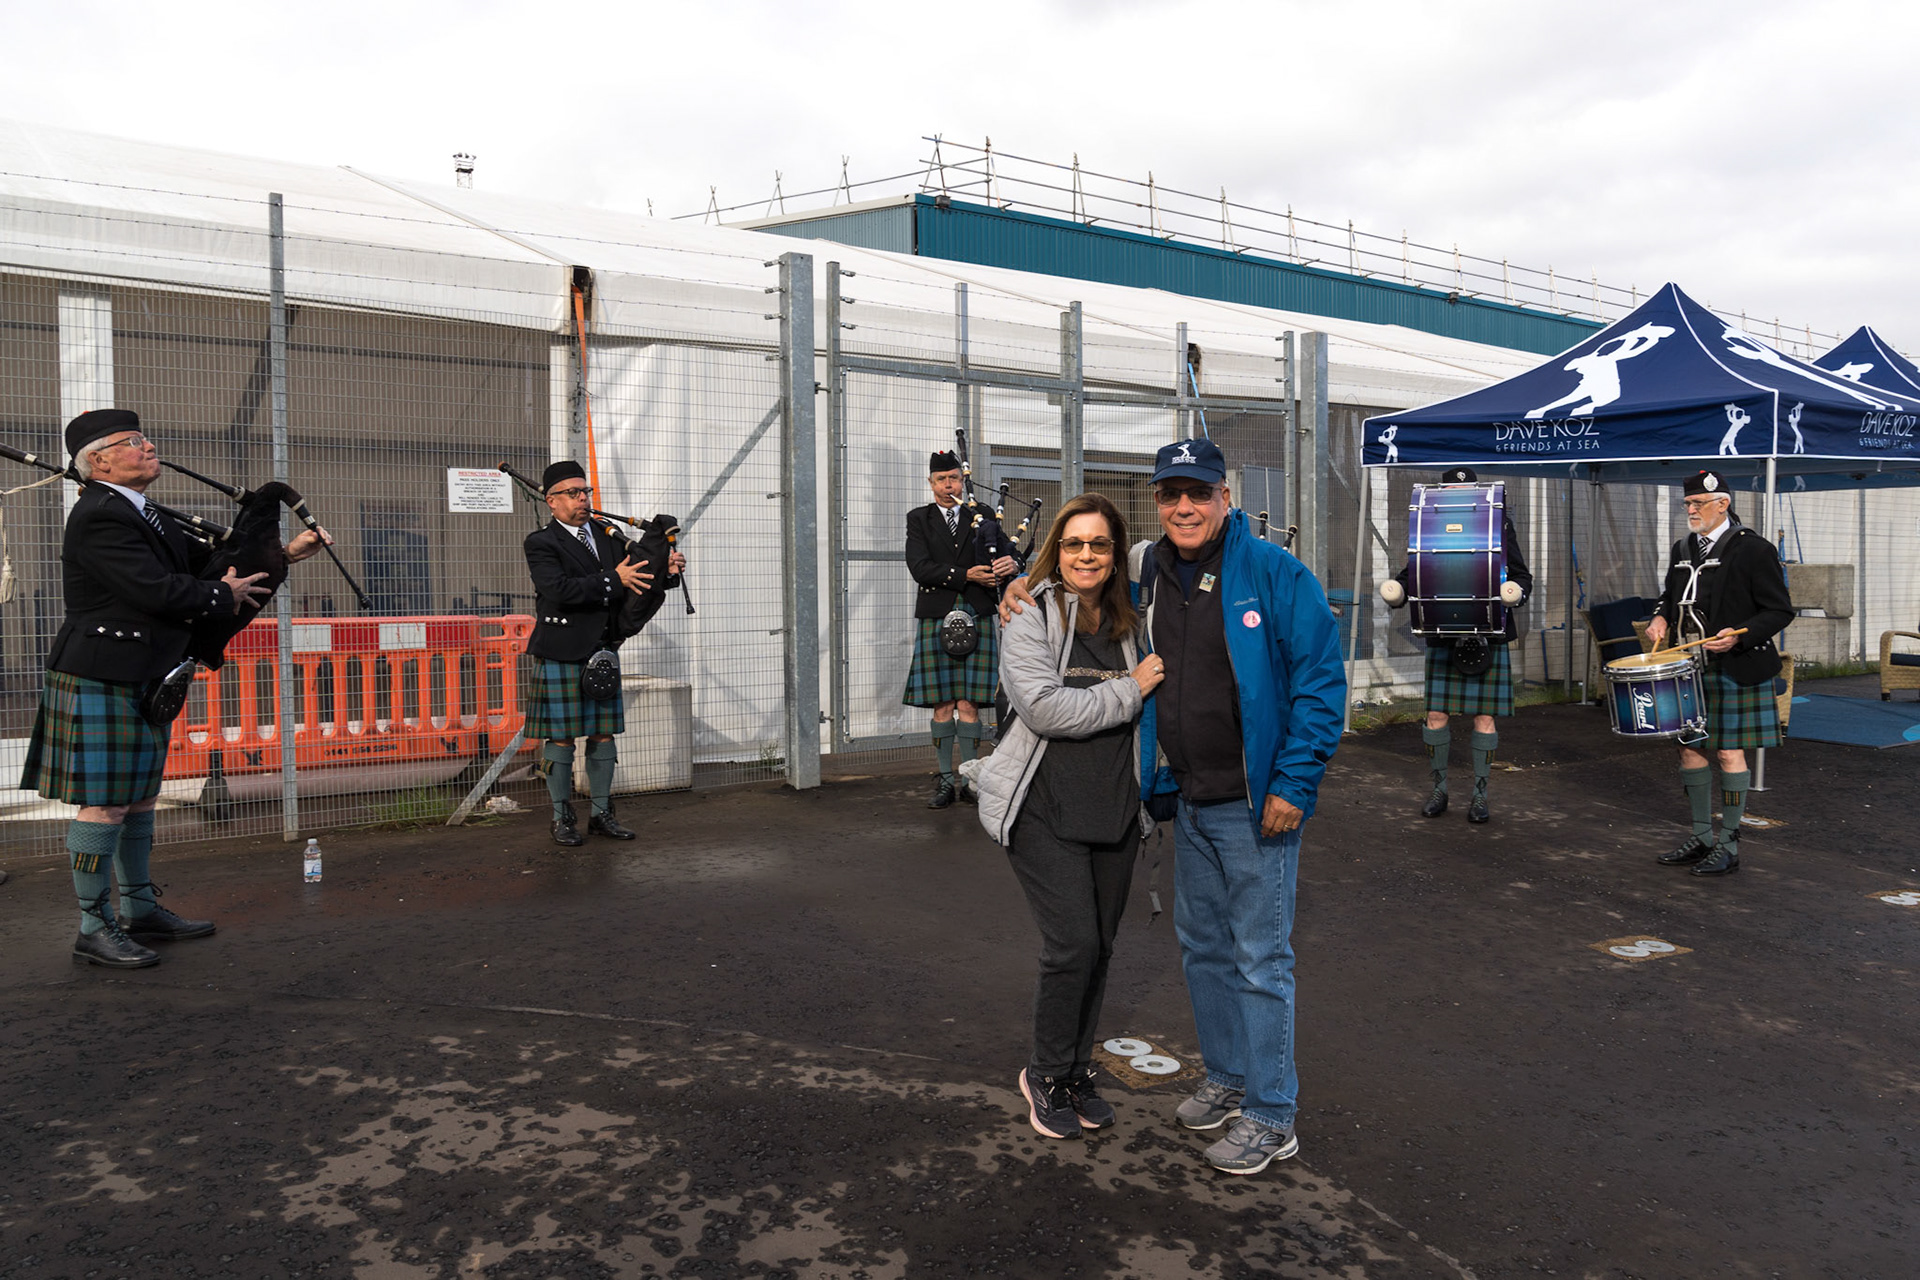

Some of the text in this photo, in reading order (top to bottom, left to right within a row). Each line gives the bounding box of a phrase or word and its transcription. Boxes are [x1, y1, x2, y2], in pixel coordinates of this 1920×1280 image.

[1493, 417, 1600, 441] DAVE KOZ
[1860, 411, 1917, 437] DAVE KOZ
[1504, 442, 1551, 452] FRIENDS
[1557, 441, 1571, 450] AT
[1577, 440, 1600, 450] SEA
[1632, 687, 1656, 730] Pearl
